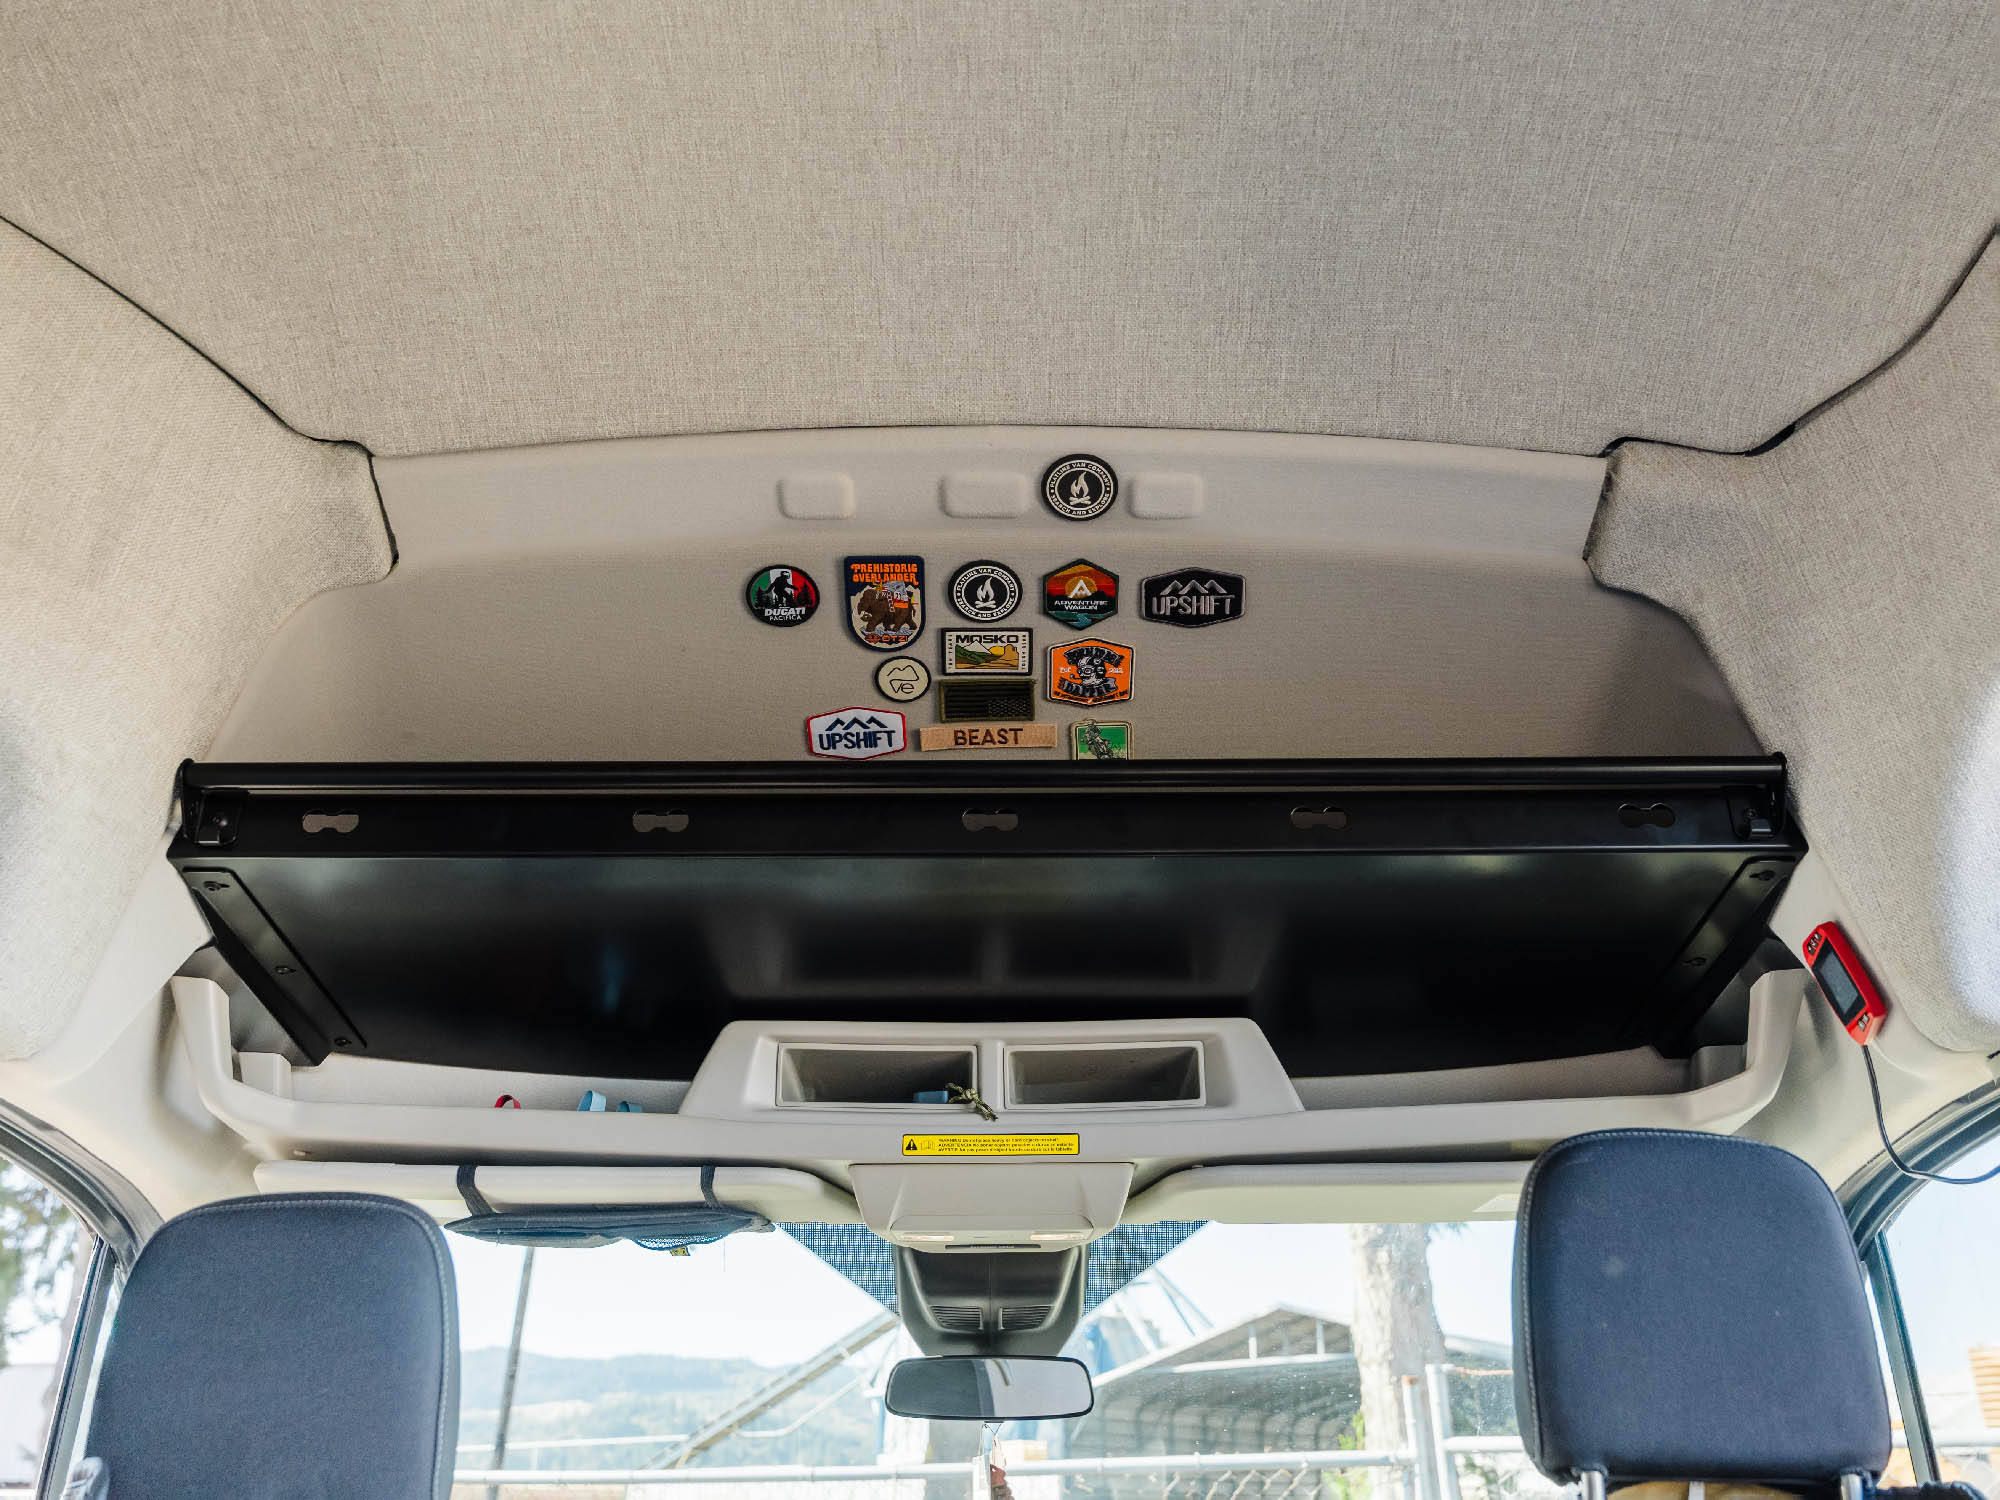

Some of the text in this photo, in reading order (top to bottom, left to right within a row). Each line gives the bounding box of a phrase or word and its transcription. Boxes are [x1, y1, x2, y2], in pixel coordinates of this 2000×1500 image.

[850, 563, 918, 573] PREHISTORIC
[852, 573, 919, 585] OVERLANDER
[1152, 595, 1235, 615] UPSHIFT
[764, 607, 806, 616] DUCATI
[955, 634, 1019, 643] MOSKO
[818, 730, 896, 750] UPSHIFT
[954, 727, 1023, 746] BEAST
